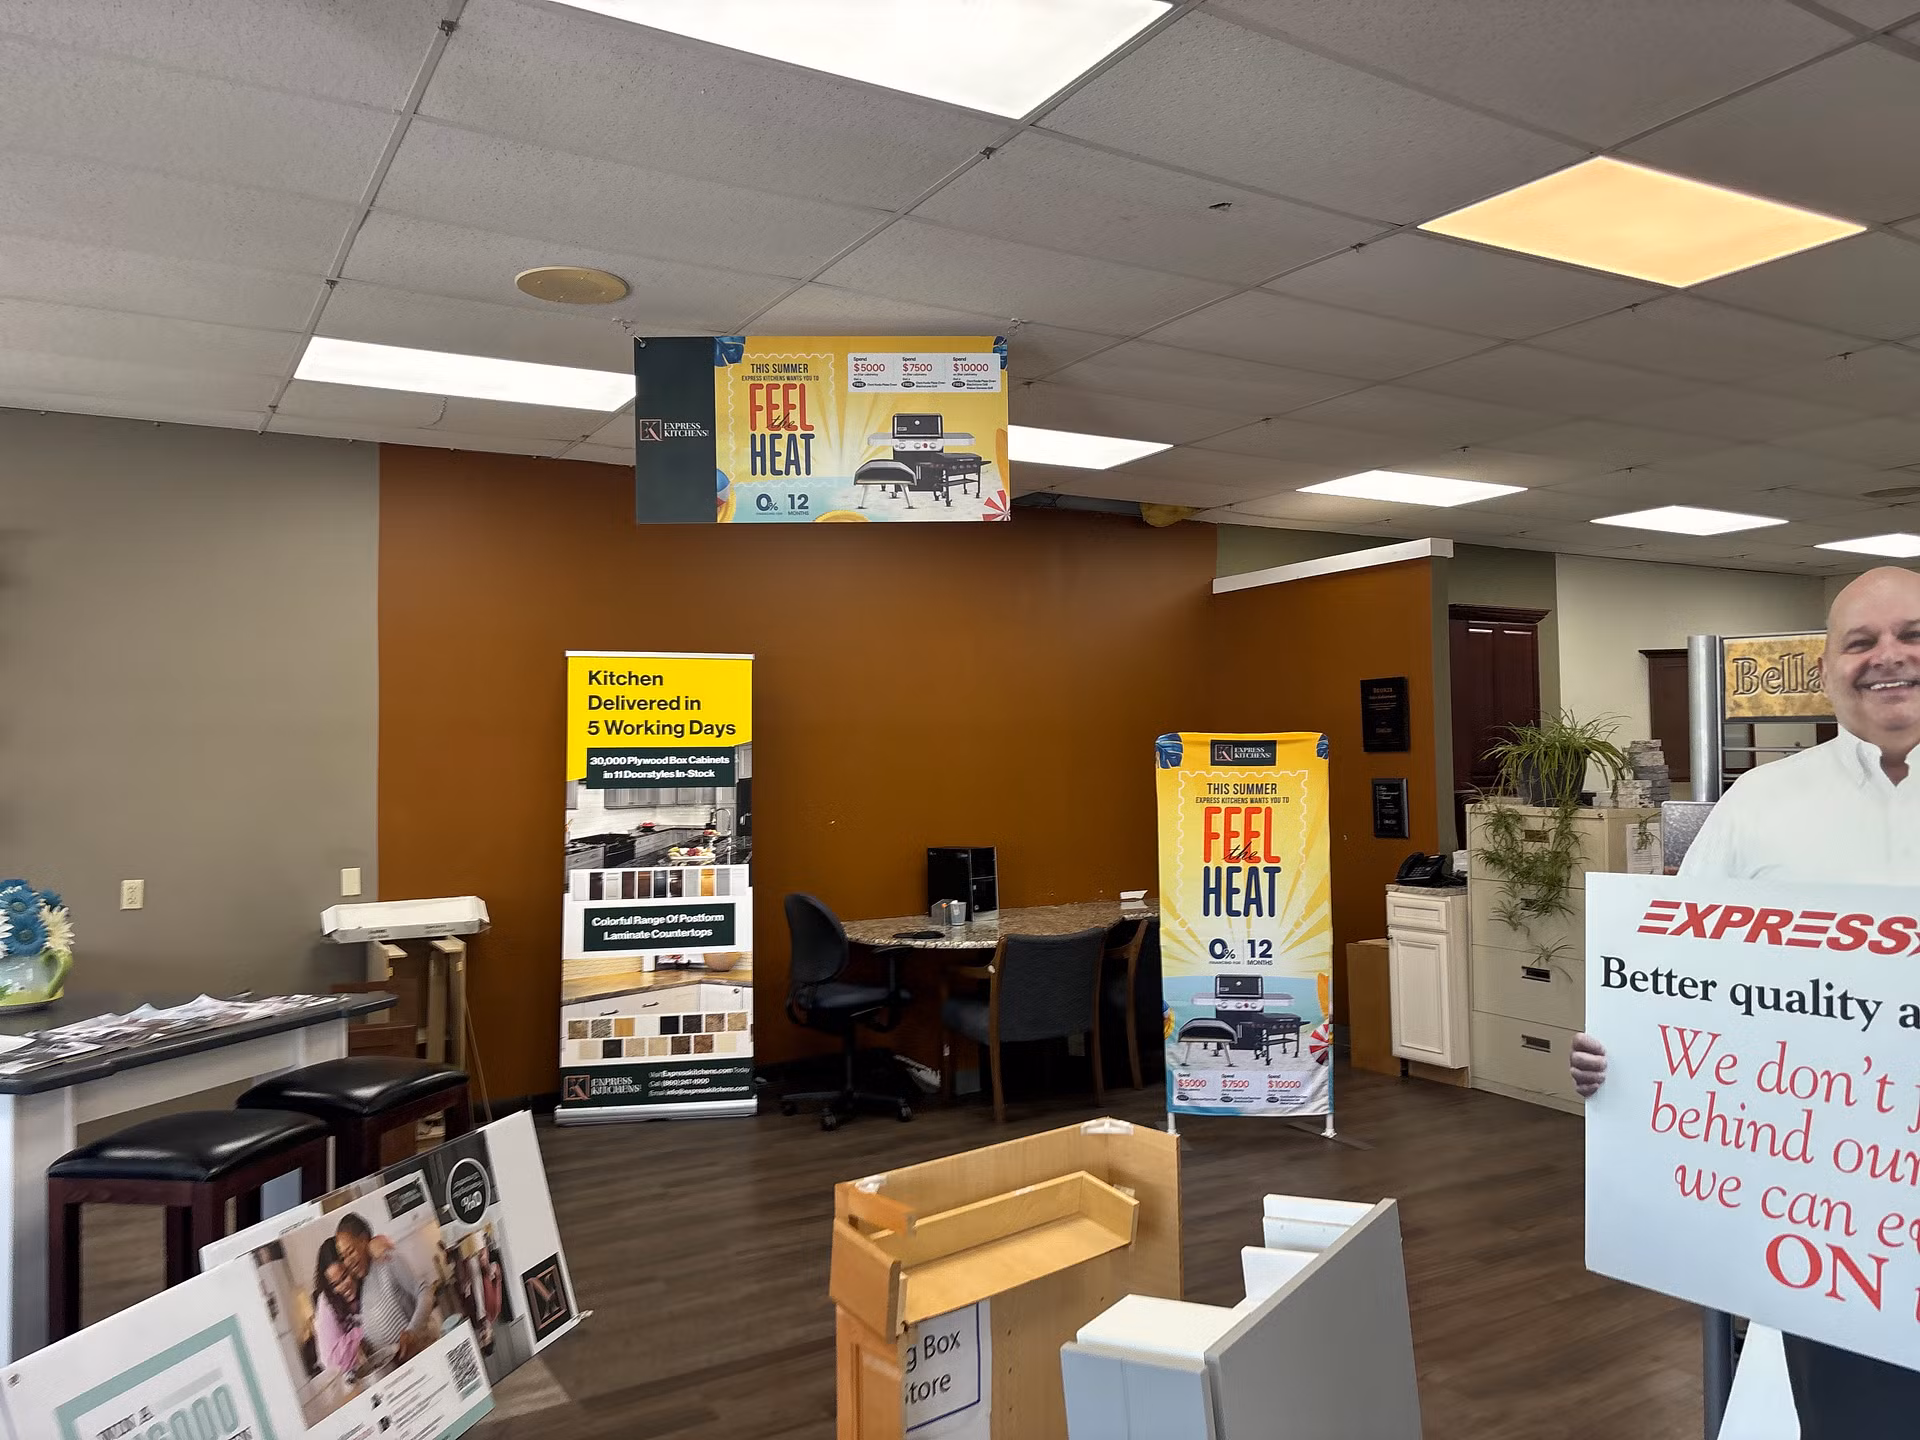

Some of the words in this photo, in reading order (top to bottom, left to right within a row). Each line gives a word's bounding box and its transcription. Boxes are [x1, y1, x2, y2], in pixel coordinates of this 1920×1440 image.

[750, 363, 770, 373] THIS
[772, 363, 809, 374] SUMMER
[853, 363, 885, 372] $5000
[902, 363, 932, 372] $7500
[953, 363, 989, 372] $10000
[750, 383, 814, 431] FEEL
[664, 422, 701, 430] EXPRESS
[766, 412, 795, 428] the
[751, 433, 815, 476] HEAT
[756, 493, 779, 511] 0%
[788, 494, 809, 510] 12
[588, 670, 664, 686] Kitchen
[588, 695, 681, 710] Delivered
[684, 696, 702, 710] in
[587, 720, 600, 736] 5
[604, 720, 686, 738] Working
[689, 720, 737, 738] Days
[589, 756, 627, 766] 30,000
[627, 756, 669, 767] Plywood
[669, 756, 688, 765] Box
[688, 755, 730, 765] Cabinets
[603, 770, 614, 779] in
[614, 770, 623, 779] 11
[623, 770, 675, 780] Doorstyles
[675, 769, 716, 778] In-Stock
[1207, 783, 1230, 795] THIS
[1232, 783, 1277, 795] SUMMER
[1195, 796, 1220, 804] EXPRESS
[1270, 796, 1281, 804] YOU
[1282, 796, 1290, 804] TO
[1204, 806, 1281, 863] FEEL
[1221, 841, 1258, 861] the
[1203, 866, 1281, 918] HEAT
[591, 916, 633, 927] Colorful
[633, 915, 666, 926] Range
[666, 914, 680, 923] Of
[679, 913, 725, 923] Postform
[1637, 900, 1917, 955] EXPRESS
[603, 930, 651, 941] Laminate
[651, 928, 713, 939] Countertops
[1209, 938, 1236, 959] 0%
[1247, 939, 1273, 958] 12
[1600, 956, 1717, 1002] Better
[1729, 979, 1883, 1032] quality
[1658, 1024, 1738, 1086] We
[1756, 1040, 1895, 1113] don't
[591, 1077, 633, 1086] EXPRESS
[1178, 1079, 1207, 1088] $5000
[1222, 1080, 1249, 1088] $7500
[1268, 1080, 1301, 1089] $10000
[1650, 1081, 1815, 1164] behind
[1675, 1164, 1742, 1208] we
[1761, 1184, 1858, 1237] can
[1765, 1232, 1889, 1312] ON
[924, 1330, 961, 1360] Box
